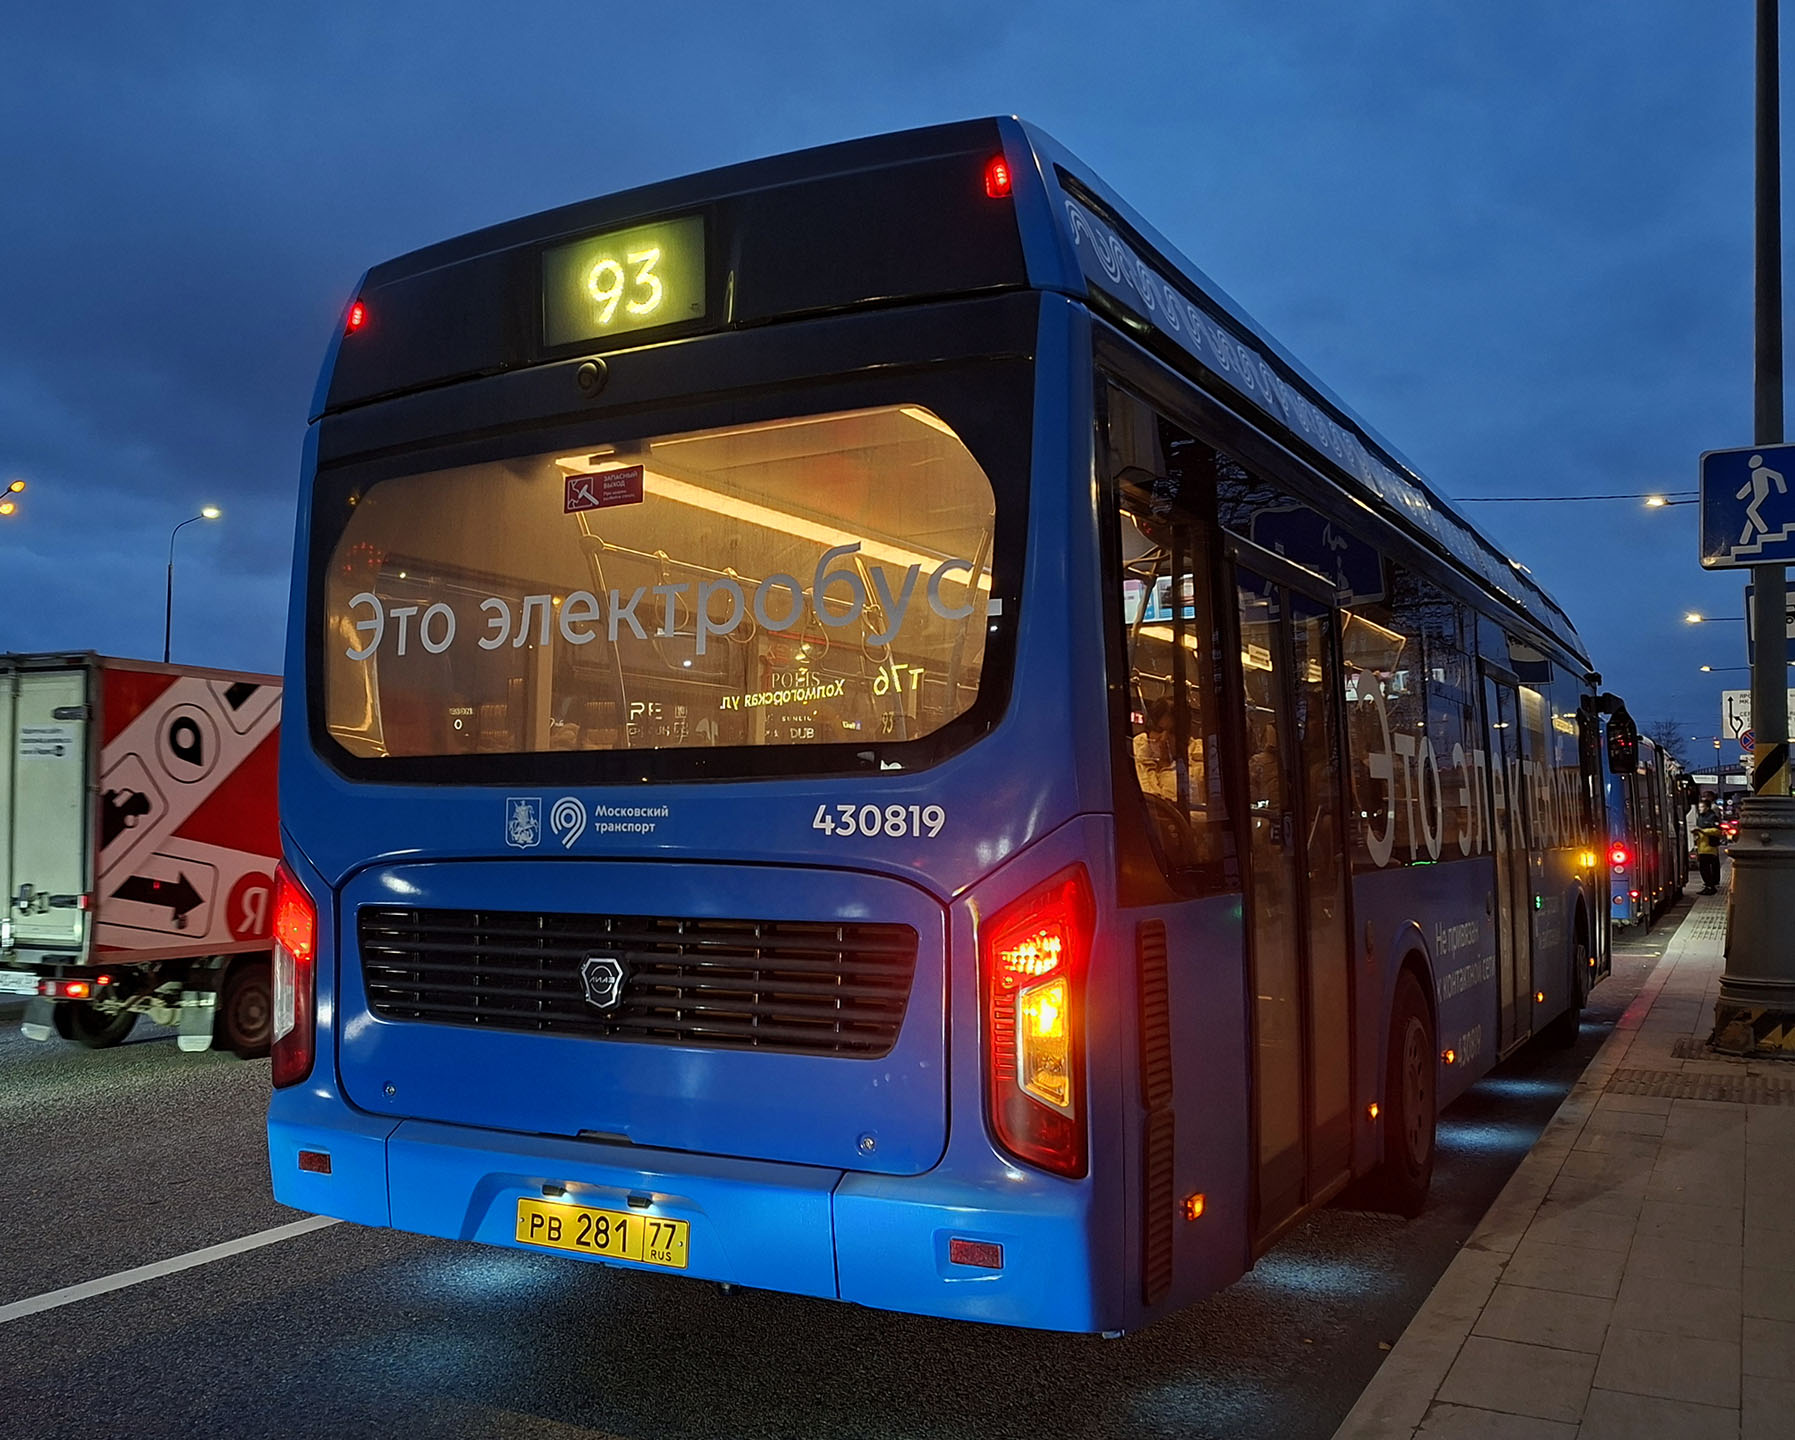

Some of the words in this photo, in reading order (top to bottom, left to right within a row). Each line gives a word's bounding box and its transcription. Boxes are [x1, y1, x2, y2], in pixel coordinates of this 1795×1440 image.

[588, 248, 662, 324] 93
[345, 592, 456, 660] Это
[478, 542, 1003, 656] электробус.
[594, 804, 670, 817] Московский
[812, 804, 945, 838] 430819
[594, 822, 656, 835] транспорт
[575, 1213, 628, 1253] 281
[649, 1222, 677, 1250] 77
[650, 1249, 672, 1262] RUS
